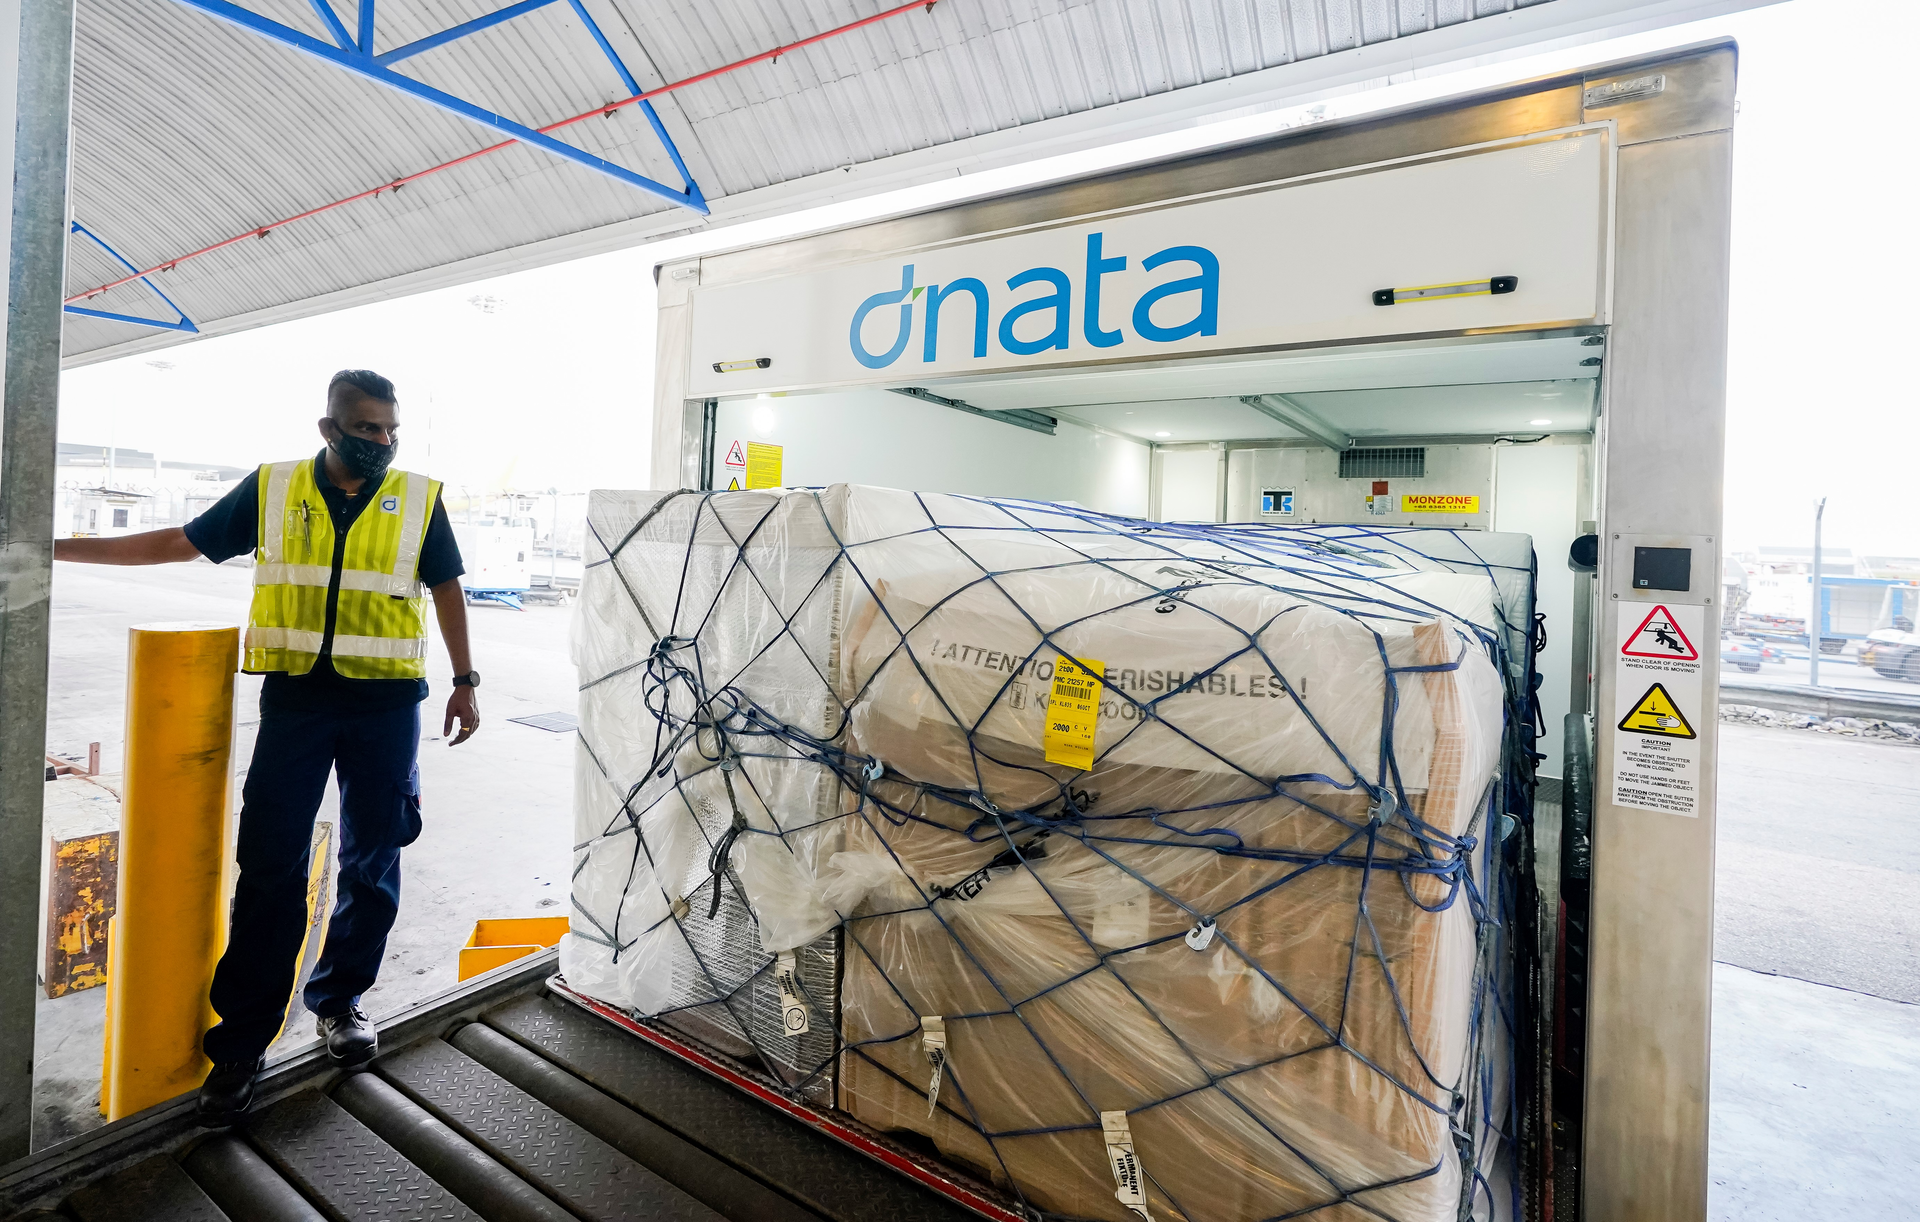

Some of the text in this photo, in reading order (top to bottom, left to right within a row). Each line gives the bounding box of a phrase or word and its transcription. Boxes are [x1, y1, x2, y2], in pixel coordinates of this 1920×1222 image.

[850, 232, 1219, 369] dnata
[1408, 496, 1472, 504] MONZONE
[942, 643, 1055, 681] ATTENTIO
[1103, 667, 1288, 699] ERISHABLES
[1052, 723, 1070, 733] 2000
[1641, 738, 1671, 746] CAUTION
[1618, 787, 1647, 795] CAUTION
[1657, 798, 1693, 808] OBSTRUCTION
